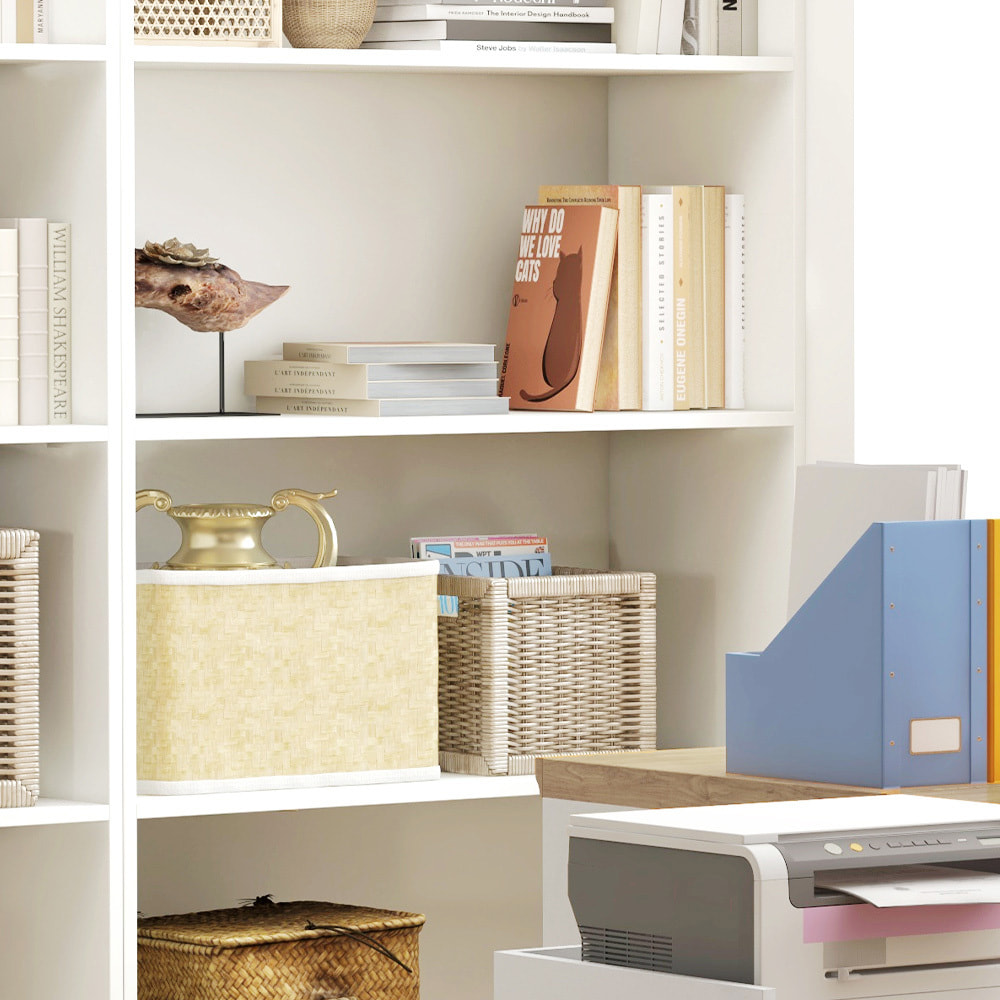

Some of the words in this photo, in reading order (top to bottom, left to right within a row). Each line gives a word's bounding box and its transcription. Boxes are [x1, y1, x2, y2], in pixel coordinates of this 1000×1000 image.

[521, 208, 549, 234] WHY
[548, 208, 565, 234] DO
[53, 228, 67, 301] WILLIAM
[519, 234, 537, 258] WE
[536, 234, 562, 258] LOVE
[515, 259, 541, 282] CATS
[676, 297, 687, 347] ONEGIN
[53, 306, 67, 419] SHAKESPEARE
[676, 350, 687, 402] EUGENE
[440, 559, 545, 578] NSIDE
